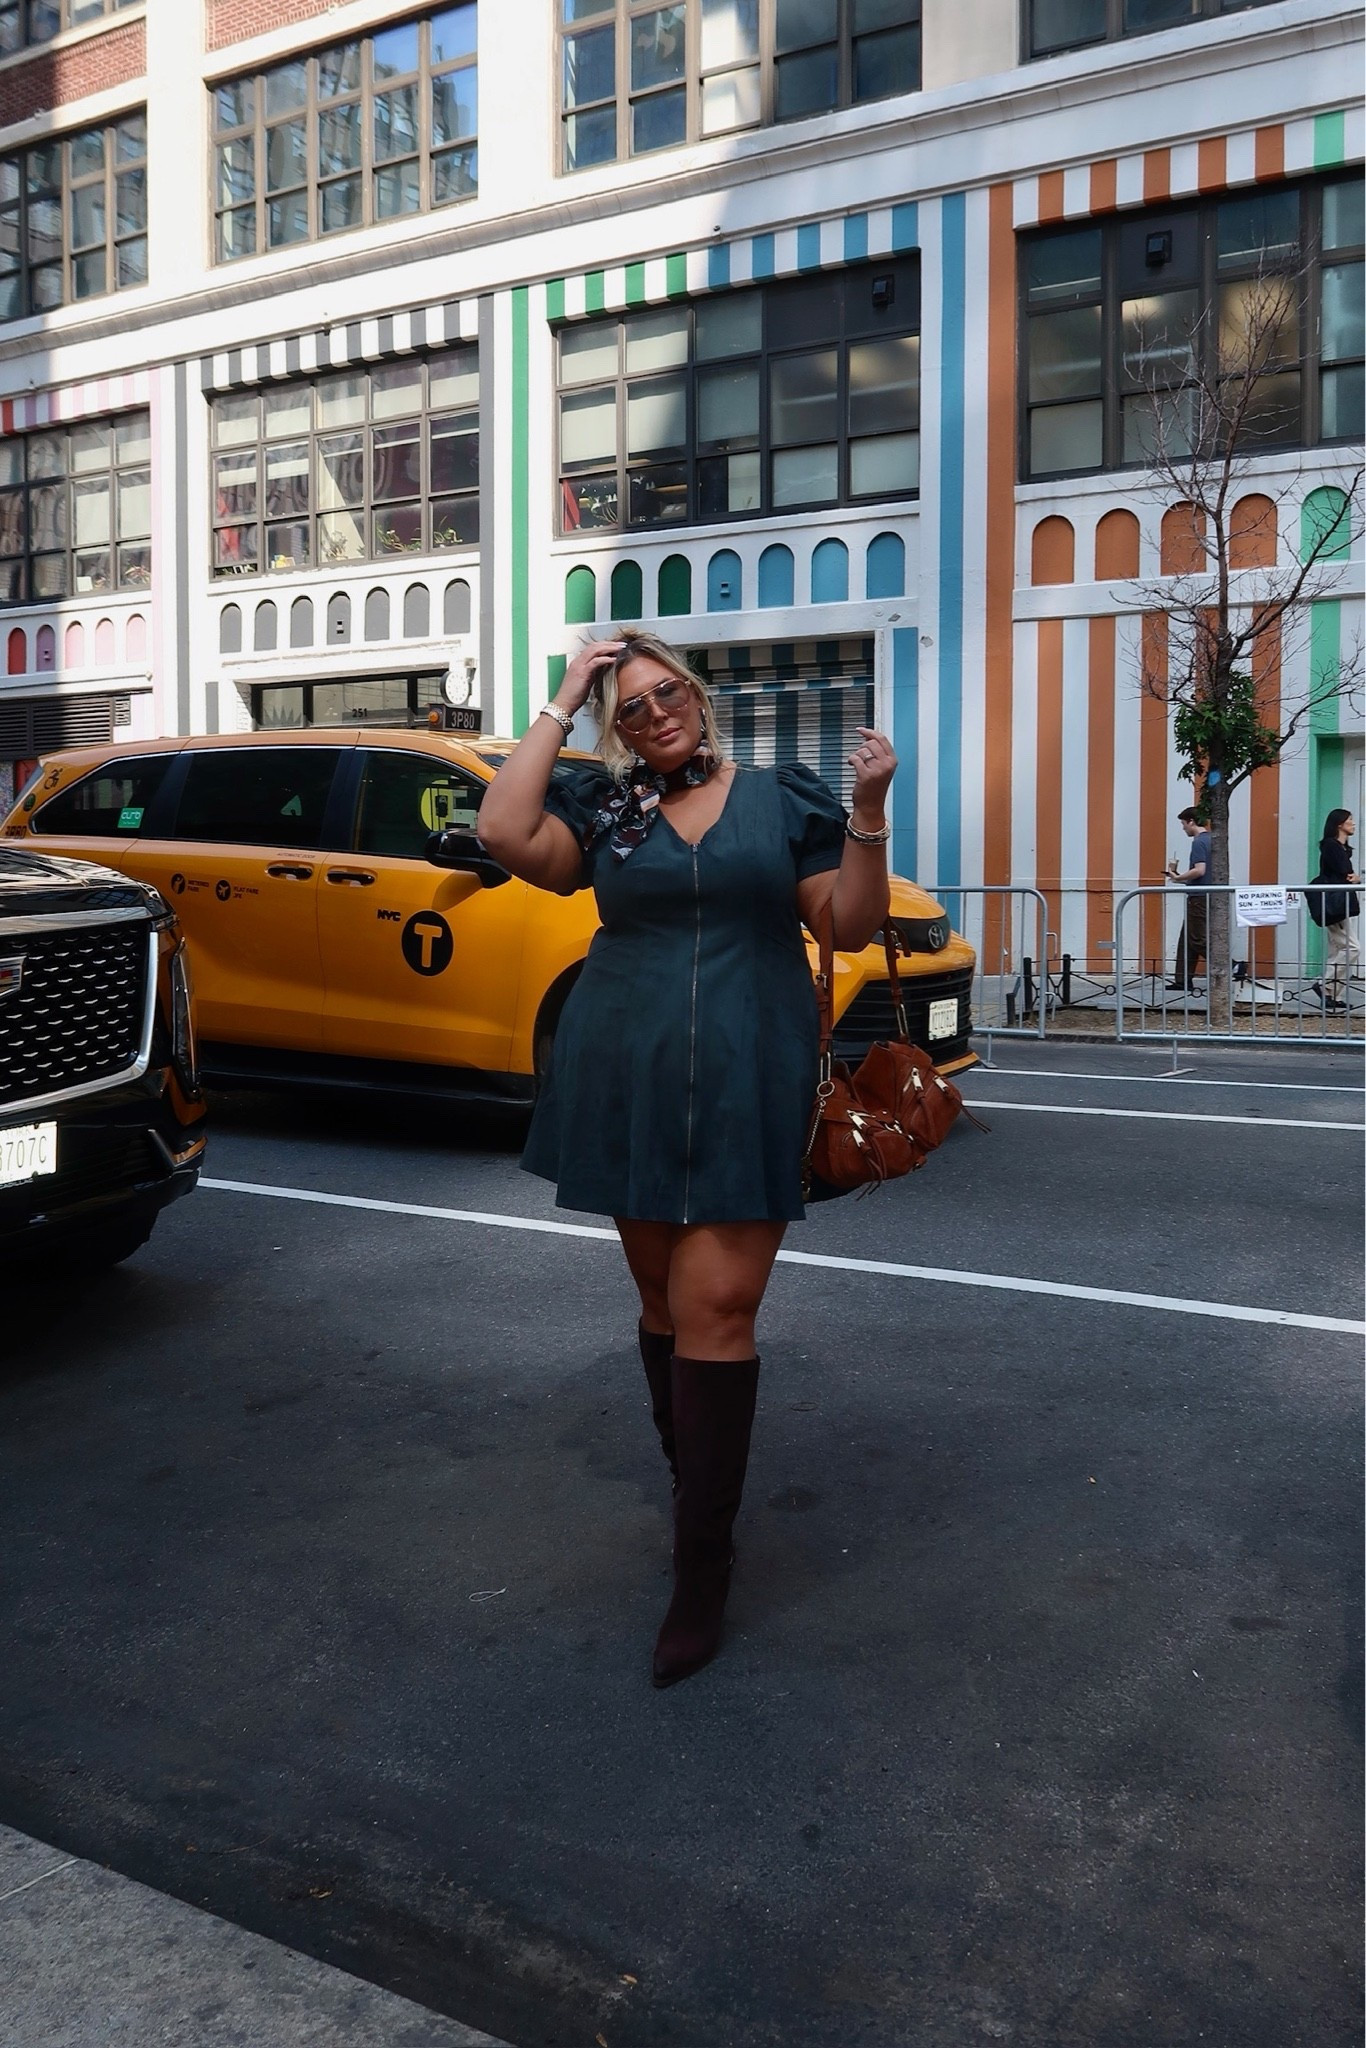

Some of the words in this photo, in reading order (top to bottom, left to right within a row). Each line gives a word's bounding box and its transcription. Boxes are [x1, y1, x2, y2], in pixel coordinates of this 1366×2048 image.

[352, 708, 367, 718] 251
[451, 711, 475, 729] 3P80
[121, 811, 141, 820] curb
[1251, 891, 1283, 899] PARKING
[377, 909, 401, 922] NYC
[414, 922, 443, 969] T
